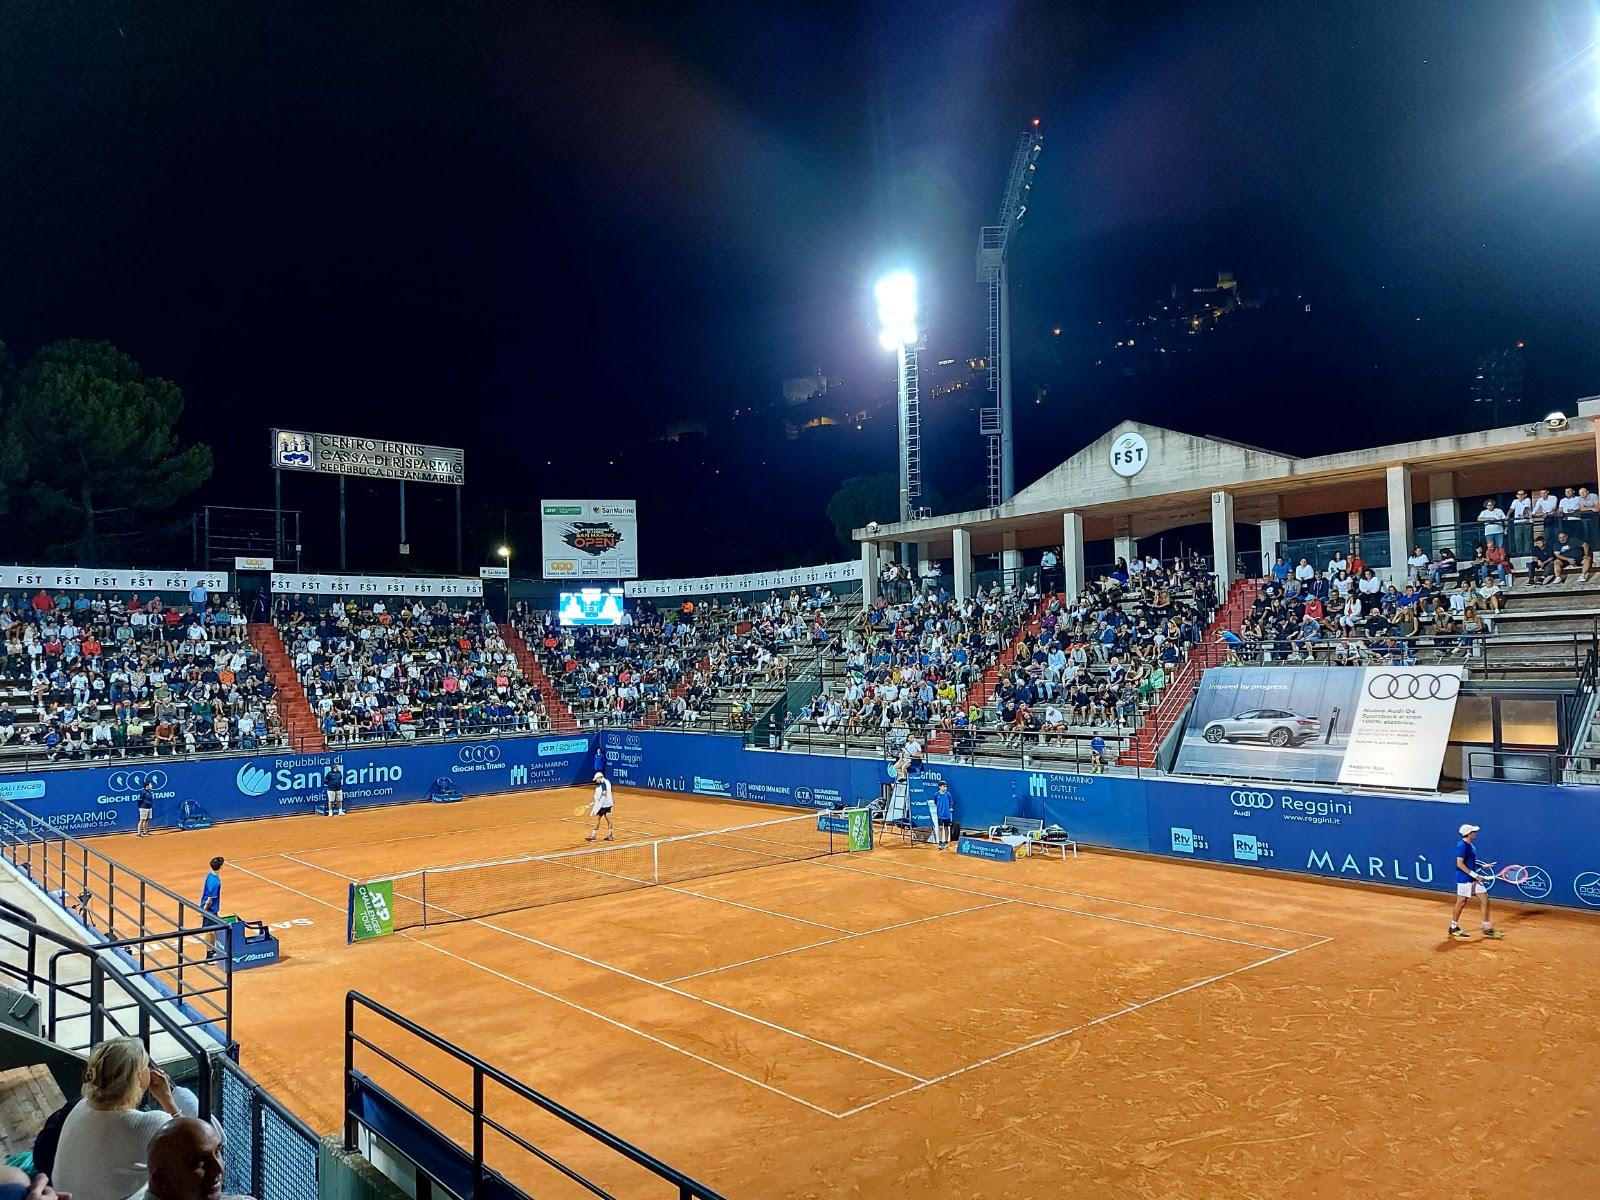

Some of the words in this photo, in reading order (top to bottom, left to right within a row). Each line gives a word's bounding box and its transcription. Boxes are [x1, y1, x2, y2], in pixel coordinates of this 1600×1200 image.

[320, 434, 376, 451] CENTRO
[381, 440, 425, 457] TENNIS
[320, 449, 370, 465] CASSA
[374, 454, 388, 466] DI
[393, 456, 463, 474] RISPARMIO
[1114, 447, 1144, 466] FST
[320, 463, 385, 476] REPUBBLICA
[386, 468, 398, 478] DI
[399, 470, 421, 480] SAN
[421, 472, 463, 484] MARINO
[573, 537, 614, 548] OPEN
[18, 575, 42, 584] FST
[56, 576, 80, 585] FST
[94, 577, 118, 586] FST
[130, 578, 153, 587] FST
[166, 578, 188, 588] FST
[678, 584, 692, 592] FST
[700, 583, 714, 591] FST
[720, 582, 733, 590] FST
[740, 580, 752, 588] FST
[758, 578, 768, 586] FST
[774, 576, 784, 584] FST
[790, 574, 800, 584] FST
[807, 573, 818, 582] FST
[824, 571, 836, 580] FST
[842, 568, 855, 577] FST
[272, 581, 290, 589] FST
[302, 582, 320, 590] FST
[331, 582, 350, 590] FST
[360, 583, 378, 592] FST
[388, 584, 405, 592] FST
[414, 584, 432, 592] FST
[441, 585, 458, 593] FST
[1208, 682, 1239, 690] Inspired
[1241, 683, 1250, 691] by
[275, 756, 331, 770] Repubblica
[334, 754, 343, 765] di
[620, 753, 643, 763] Reggini
[451, 764, 475, 773] GIOCHI
[486, 762, 506, 771] TITANO
[546, 760, 569, 769] MARINO
[530, 769, 555, 778] OUTLET
[619, 769, 628, 777] TIM
[920, 769, 942, 780] arino
[647, 775, 685, 791] MARLÙ
[1050, 774, 1064, 782] SAN
[1065, 775, 1094, 785] MARINO
[0, 784, 41, 792] ALLENGER
[748, 784, 765, 792] MONDO
[765, 785, 790, 794] IMMAGINE
[1050, 785, 1078, 794] OUTLET
[97, 794, 130, 804] GIOCHI
[151, 791, 176, 800] ITANO
[278, 786, 394, 805] www.visitmarino.com
[1281, 796, 1353, 816] Reggini
[48, 810, 118, 826] RISPARMIO
[1233, 809, 1251, 817] Audi
[1283, 814, 1341, 825] www.reggini.it
[70, 821, 98, 830] MARINO
[1174, 832, 1190, 844] Rtv
[1193, 841, 1209, 849] 831
[1236, 840, 1254, 851] Rtv
[1257, 848, 1274, 857] 831
[1306, 848, 1433, 883] MARLÙ
[358, 886, 382, 935] CHALLENGER
[368, 888, 390, 922] ATP
[360, 912, 373, 932] TOUR
